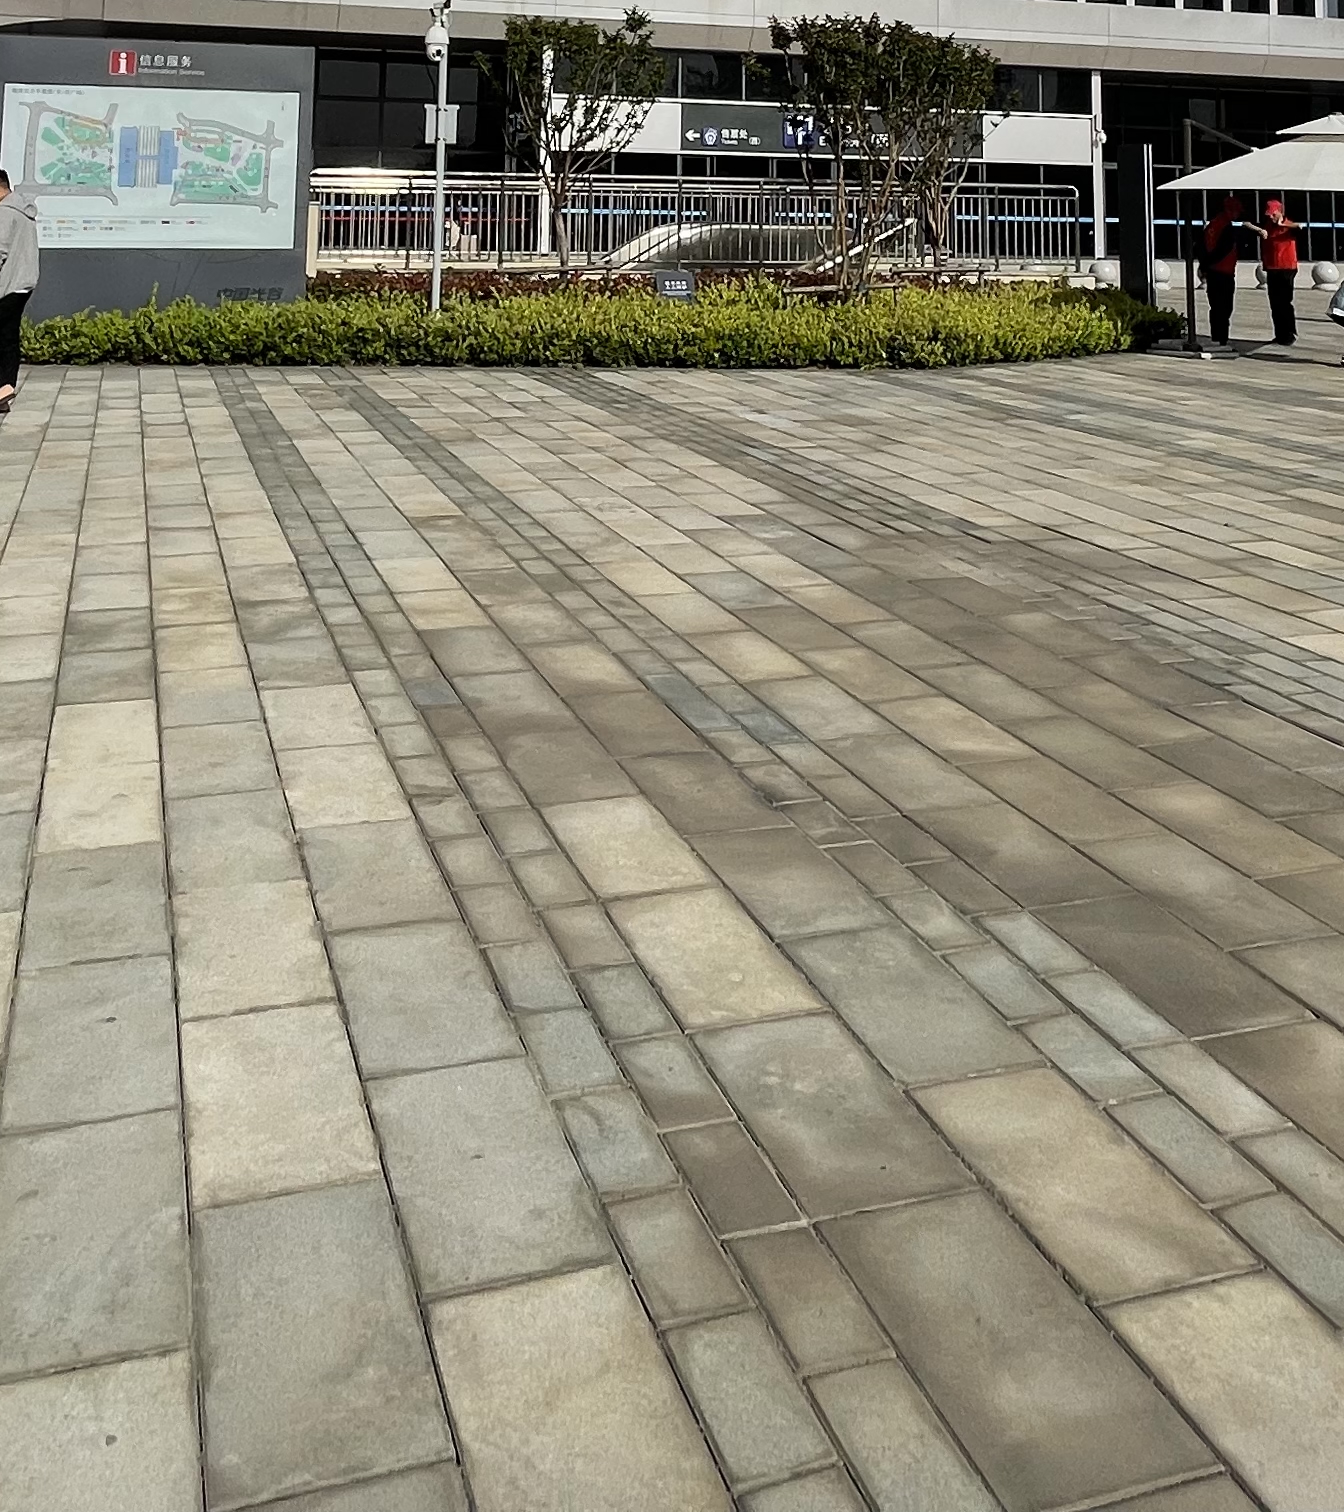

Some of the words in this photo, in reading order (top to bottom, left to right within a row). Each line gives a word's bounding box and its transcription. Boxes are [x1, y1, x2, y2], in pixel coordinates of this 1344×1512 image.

[139, 54, 192, 68] 信息服务
[216, 287, 284, 301] 中国光谷
